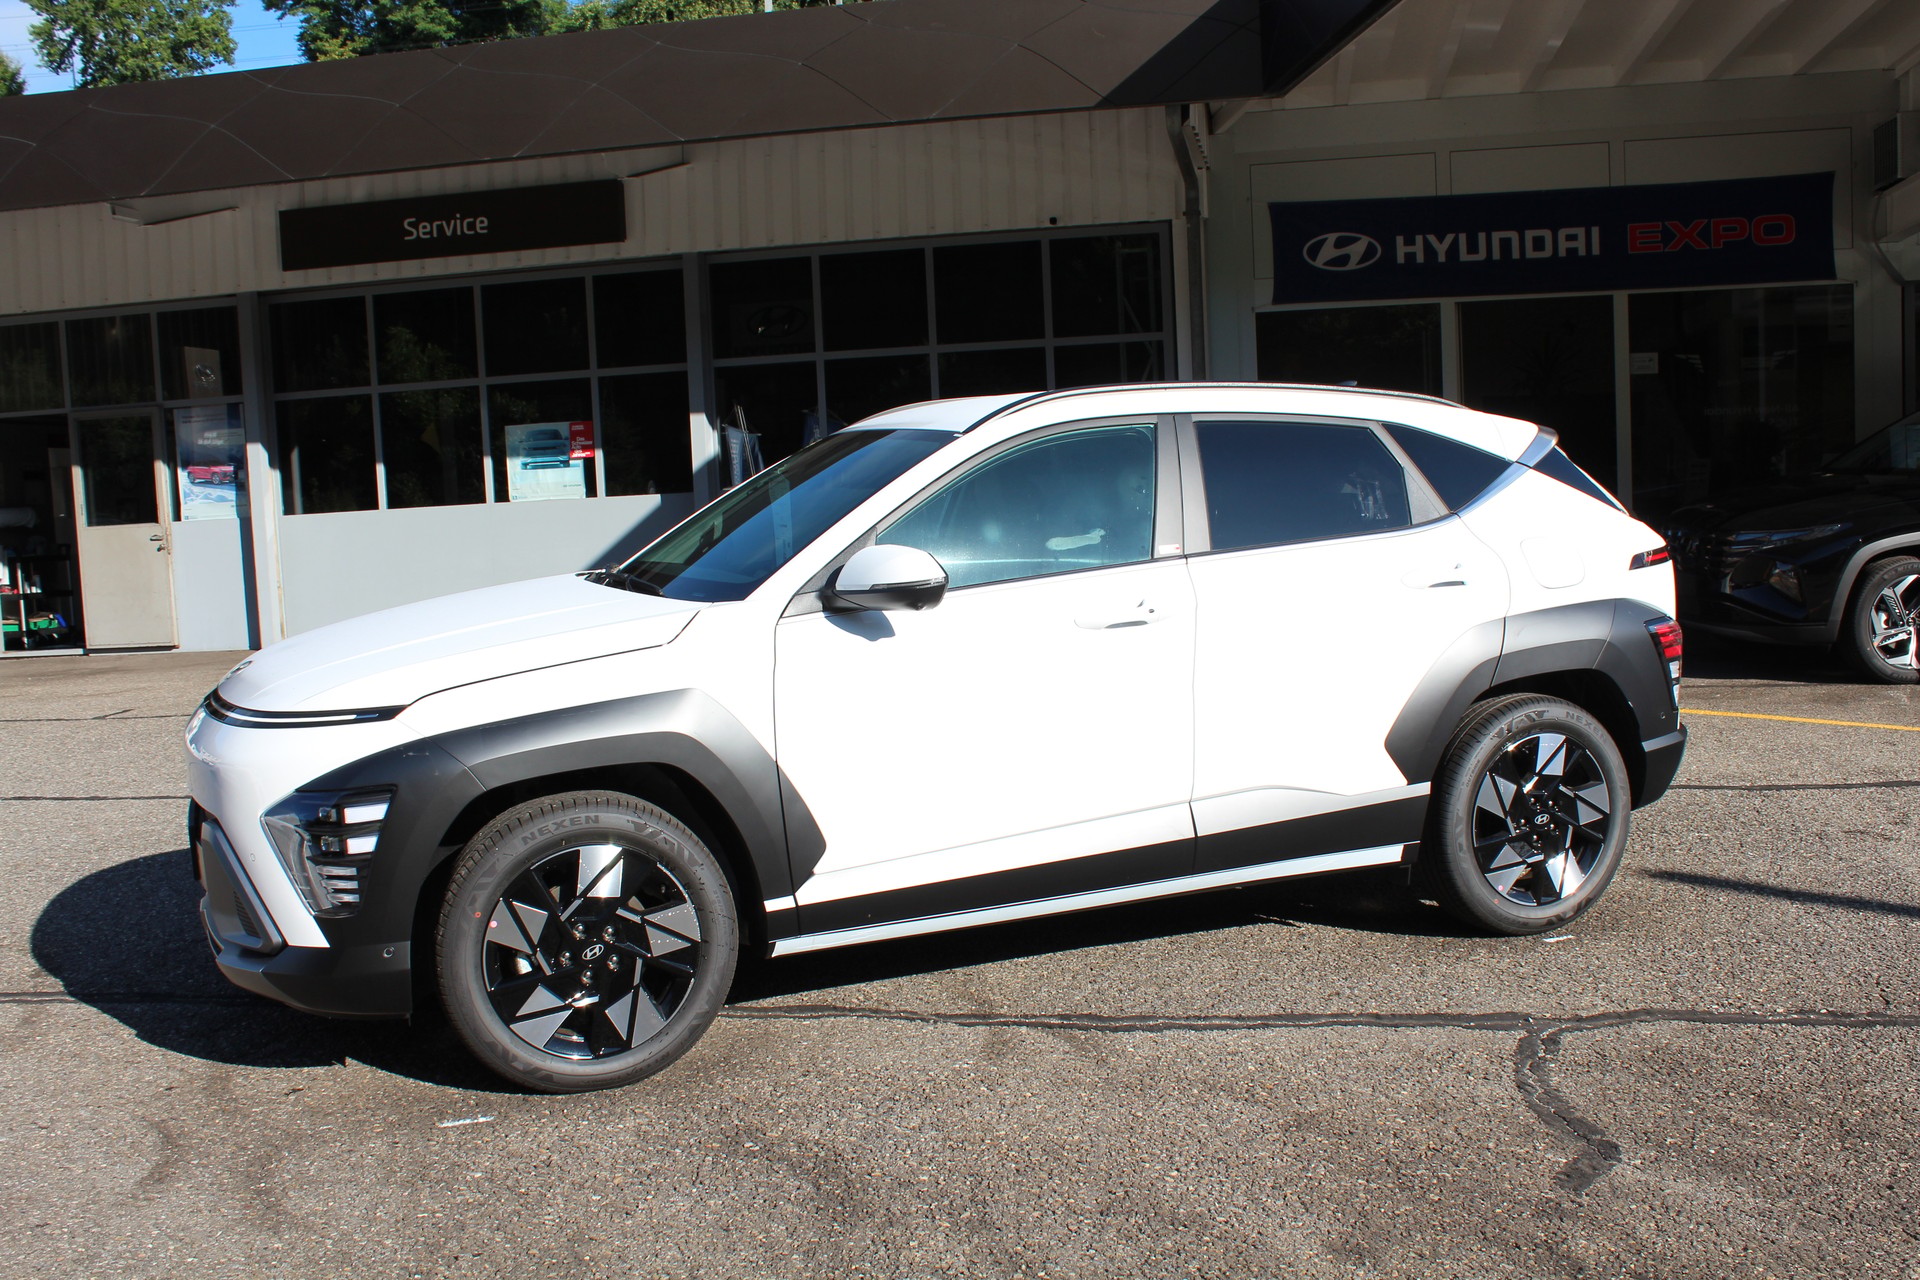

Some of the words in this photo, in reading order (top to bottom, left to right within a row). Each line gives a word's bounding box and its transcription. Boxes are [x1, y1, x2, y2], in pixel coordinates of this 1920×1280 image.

[403, 213, 488, 240] Service
[1396, 225, 1601, 264] HYUNDAI
[1627, 214, 1797, 254] EXPO
[1565, 711, 1607, 741] NEXEN
[521, 814, 600, 845] NEXEN
